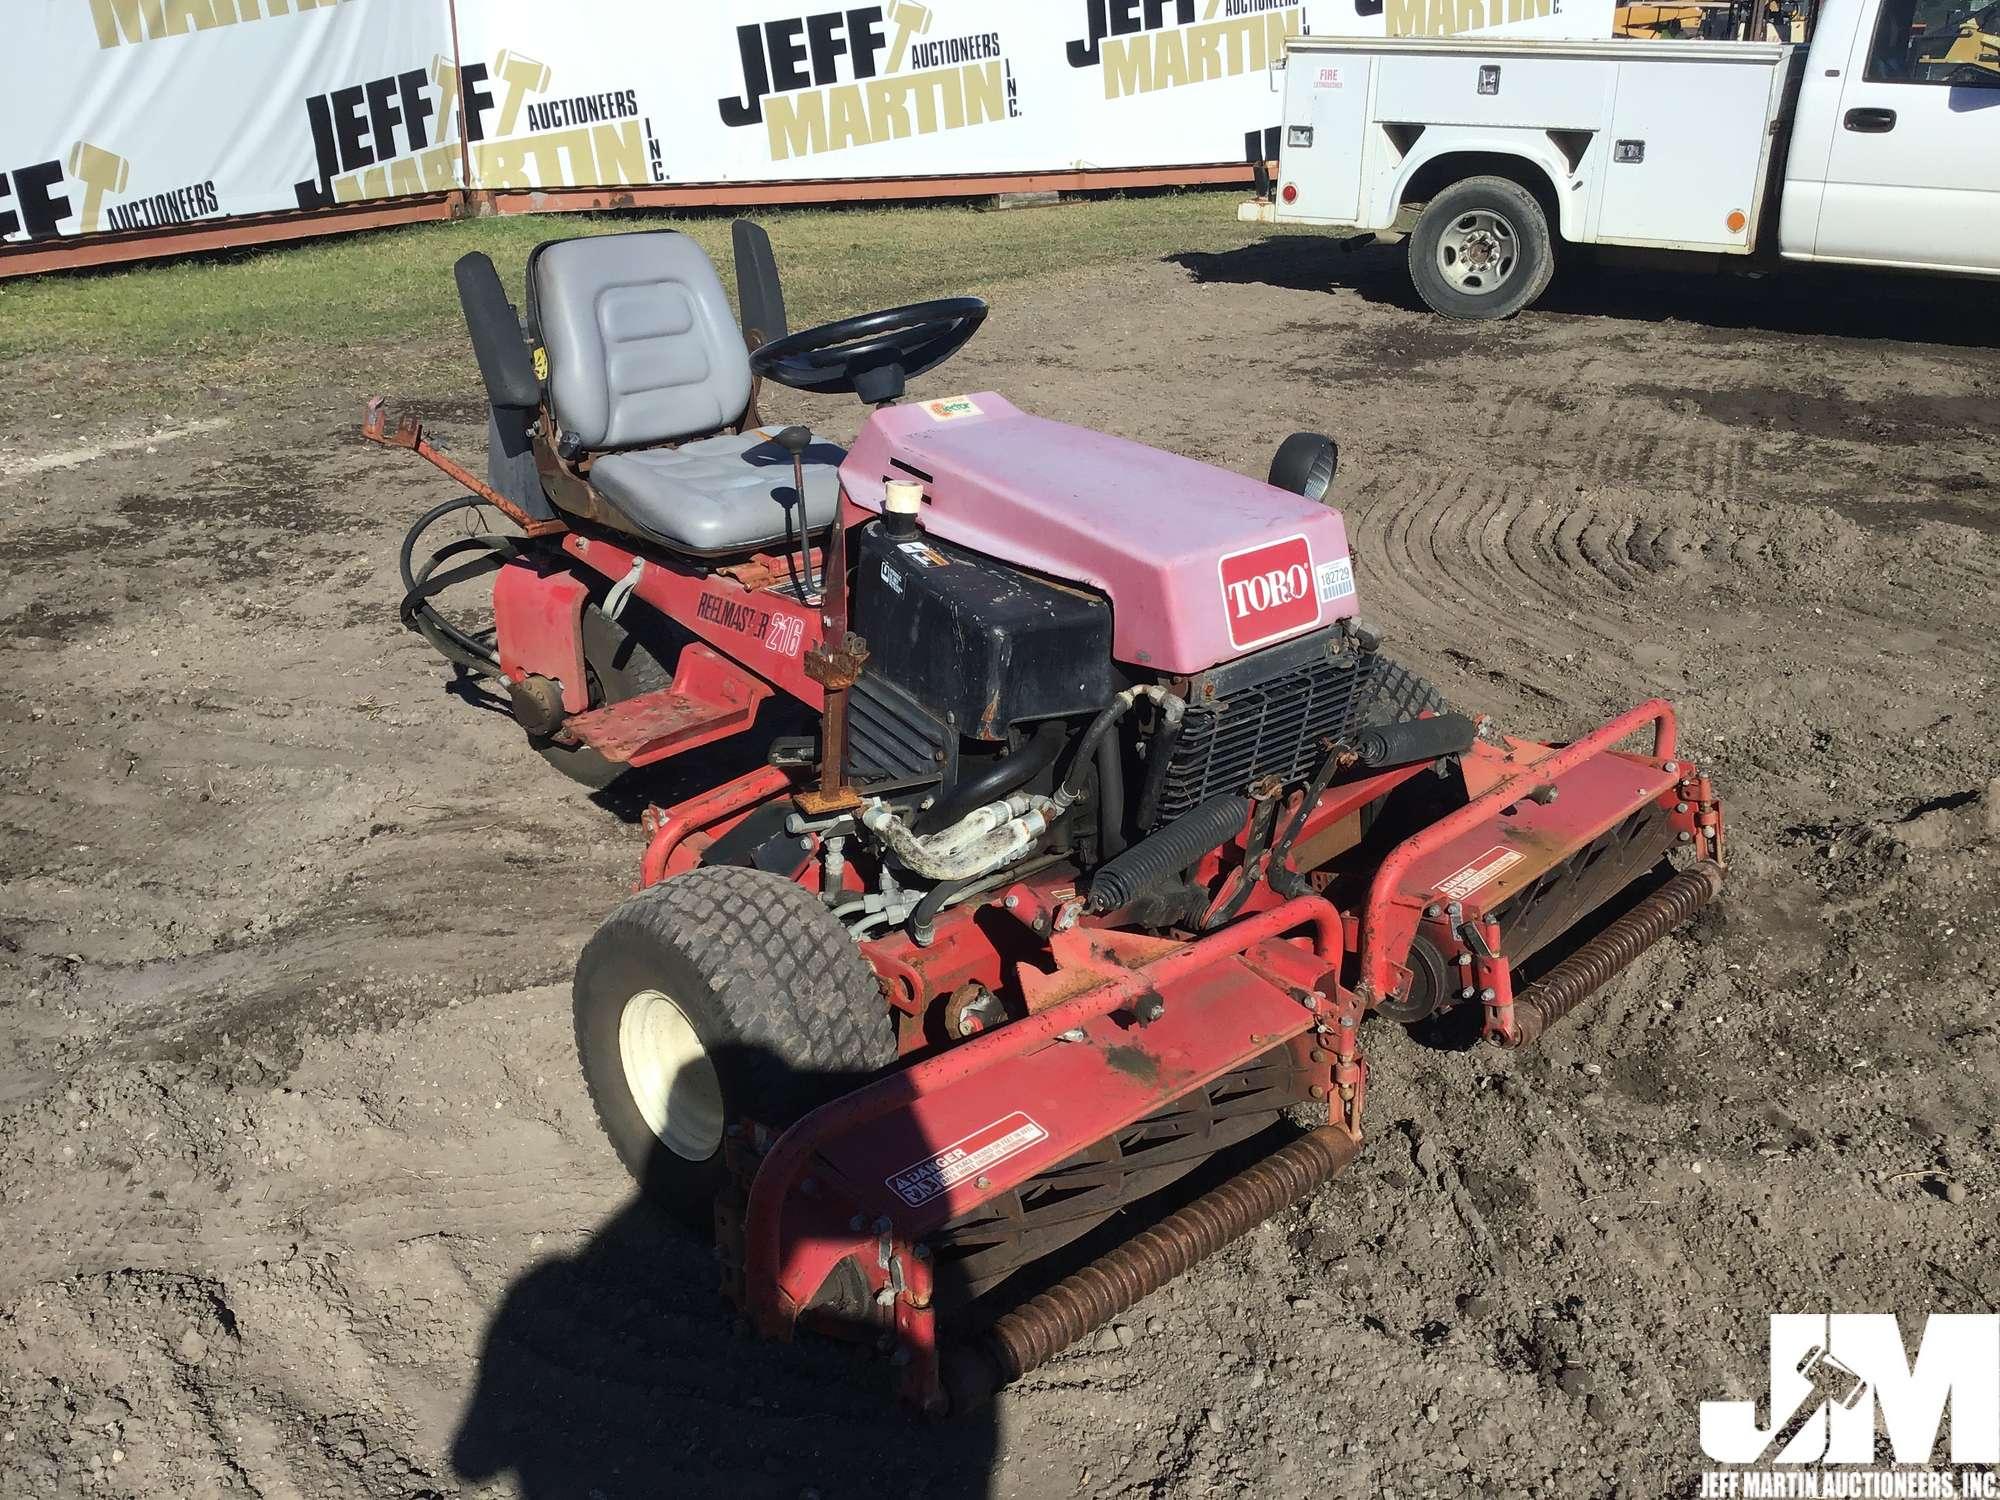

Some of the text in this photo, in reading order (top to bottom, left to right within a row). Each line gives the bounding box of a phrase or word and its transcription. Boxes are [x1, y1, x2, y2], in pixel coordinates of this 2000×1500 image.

[718, 6, 886, 127] JEFF
[911, 33, 1001, 70] AUCTIONEERS
[1102, 9, 1299, 100] MARTIN
[1320, 69, 1338, 80] FIRE
[527, 89, 638, 131] AUCTIONEERS
[763, 60, 1005, 161] MARTIN
[294, 68, 434, 208] JEFF
[106, 180, 219, 232] AUCTIONEERS
[1228, 564, 1308, 618] TORO
[1321, 566, 1350, 587] 182729
[697, 592, 770, 640] REELMASTR
[765, 612, 804, 657] 216
[906, 1148, 967, 1184] DANGER
